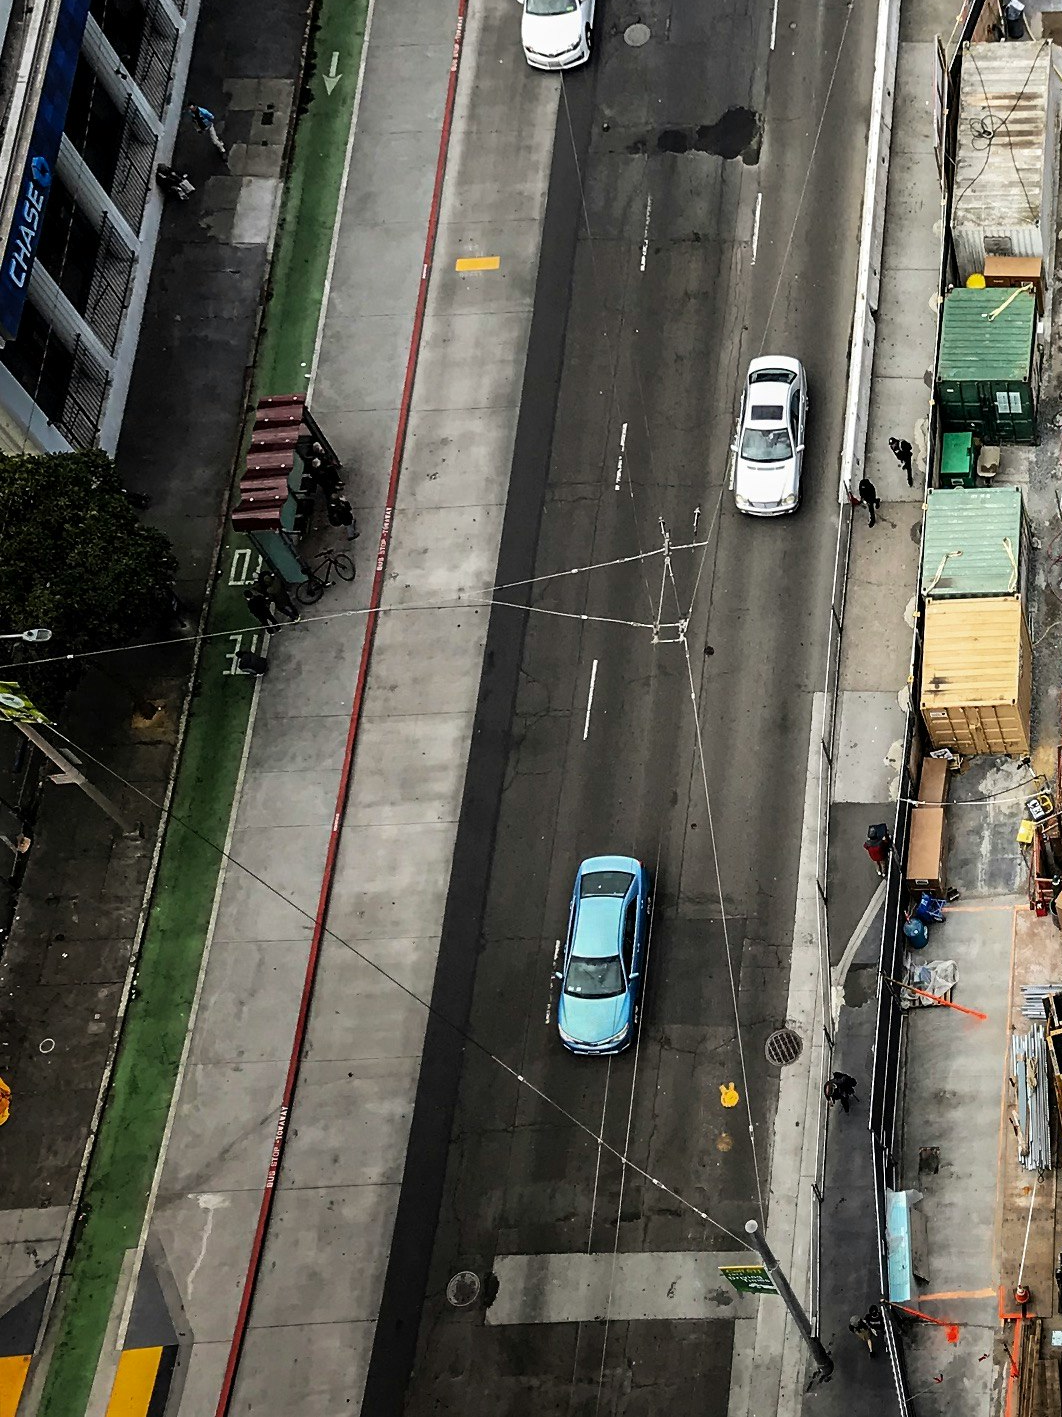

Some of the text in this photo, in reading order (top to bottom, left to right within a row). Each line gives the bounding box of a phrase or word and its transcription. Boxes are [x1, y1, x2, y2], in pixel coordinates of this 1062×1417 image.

[9, 180, 44, 289] CHASE
[377, 538, 387, 555] STOP
[376, 557, 385, 571] BUS
[270, 1146, 280, 1167] STOP
[266, 1170, 276, 1188] BUS
